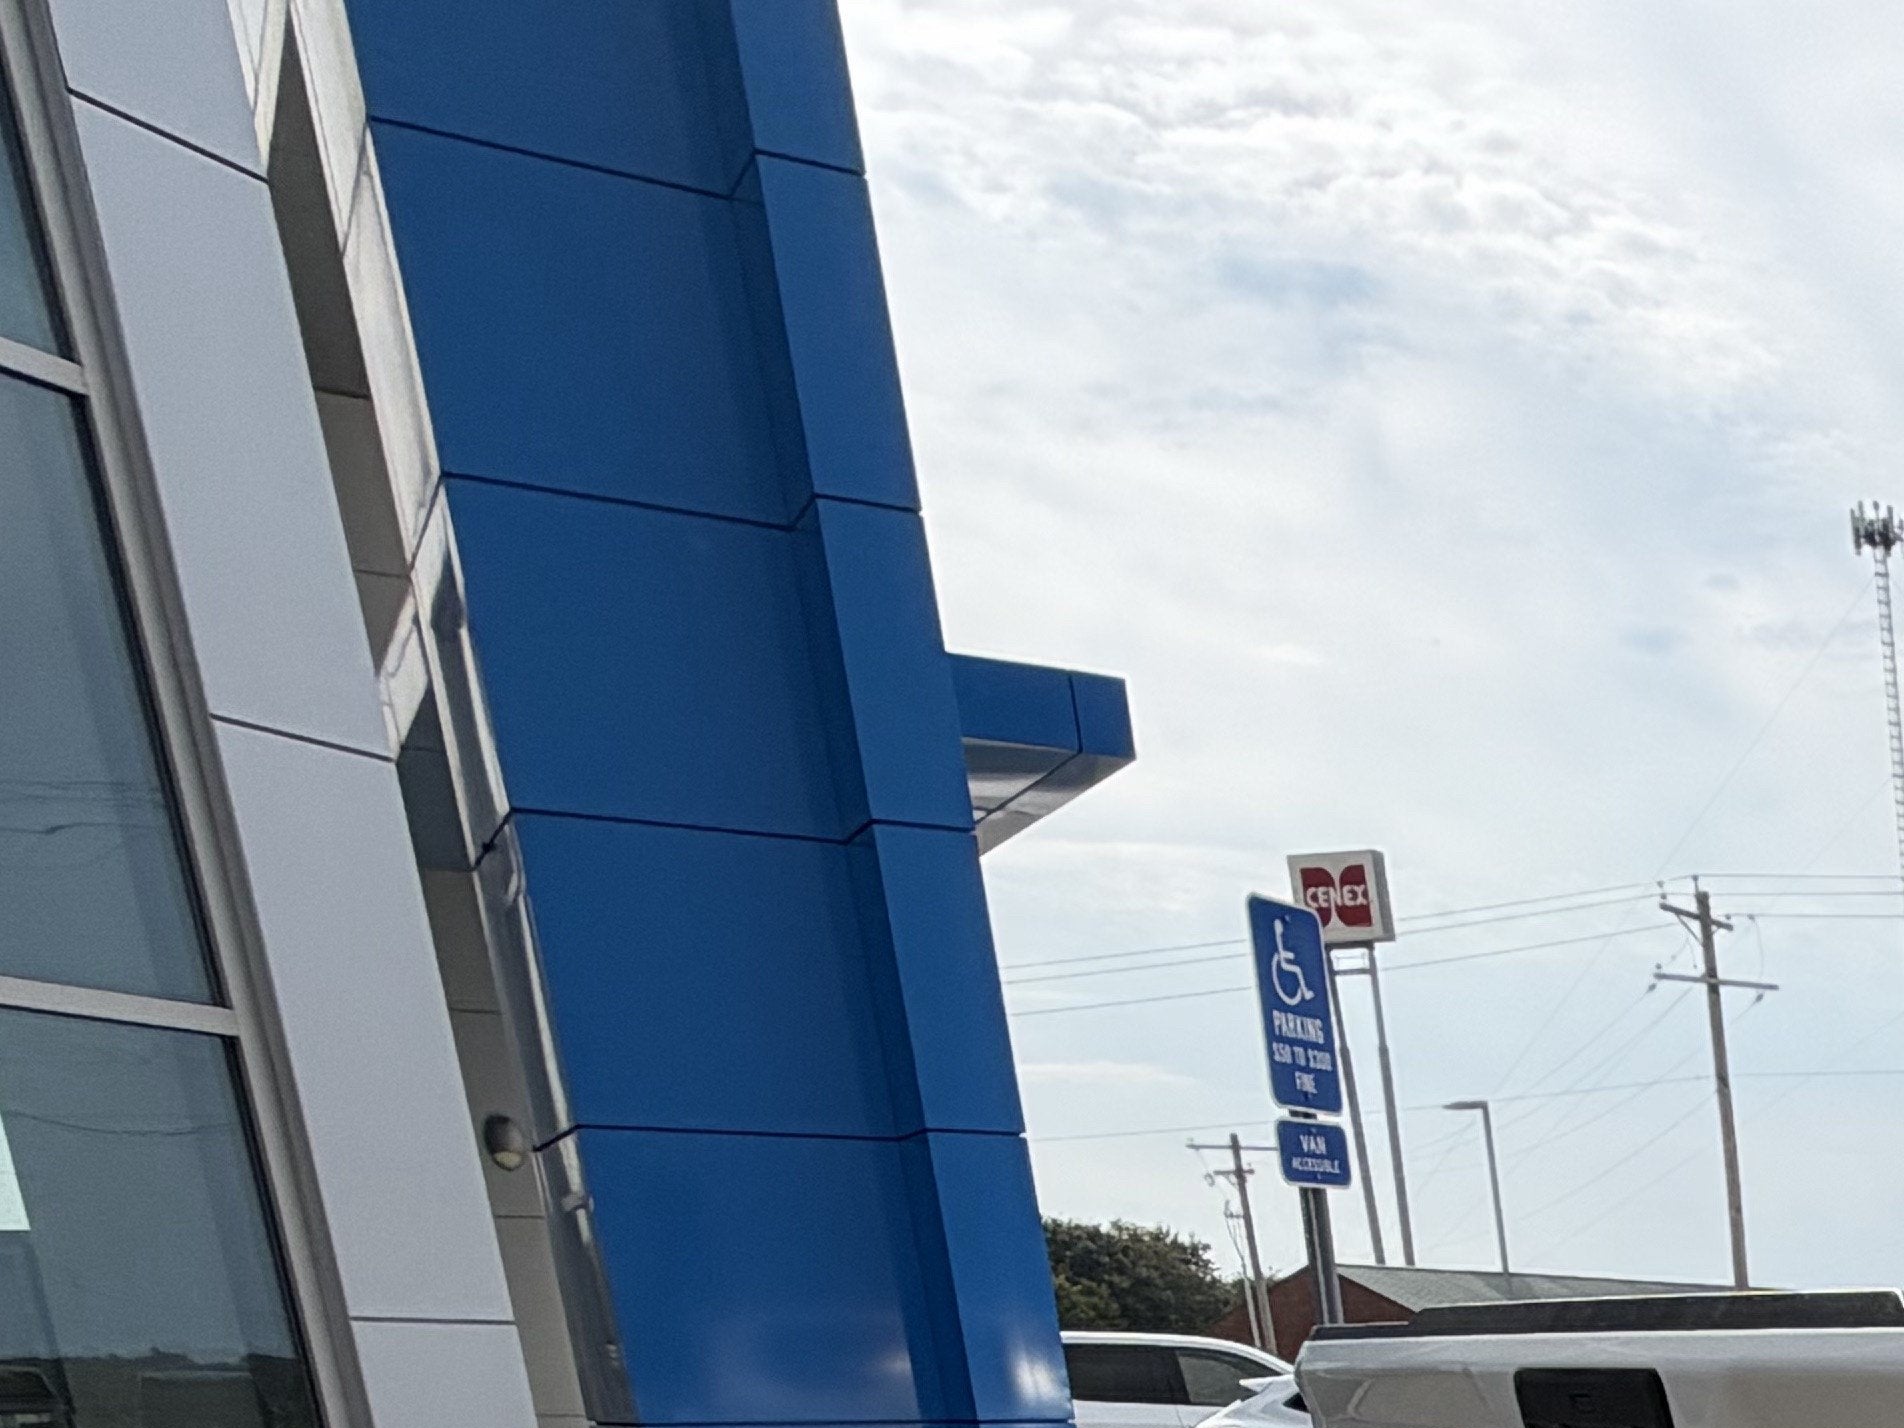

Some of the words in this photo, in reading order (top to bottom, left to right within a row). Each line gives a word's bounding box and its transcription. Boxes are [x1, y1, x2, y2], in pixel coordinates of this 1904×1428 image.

[1305, 884, 1369, 908] CENEX
[1272, 1009, 1325, 1044] PARKING
[1293, 1045, 1307, 1067] TO
[1295, 1071, 1318, 1094] FINE
[1300, 1134, 1327, 1155] VAN
[1291, 1156, 1341, 1174] ACCESSIBLE
